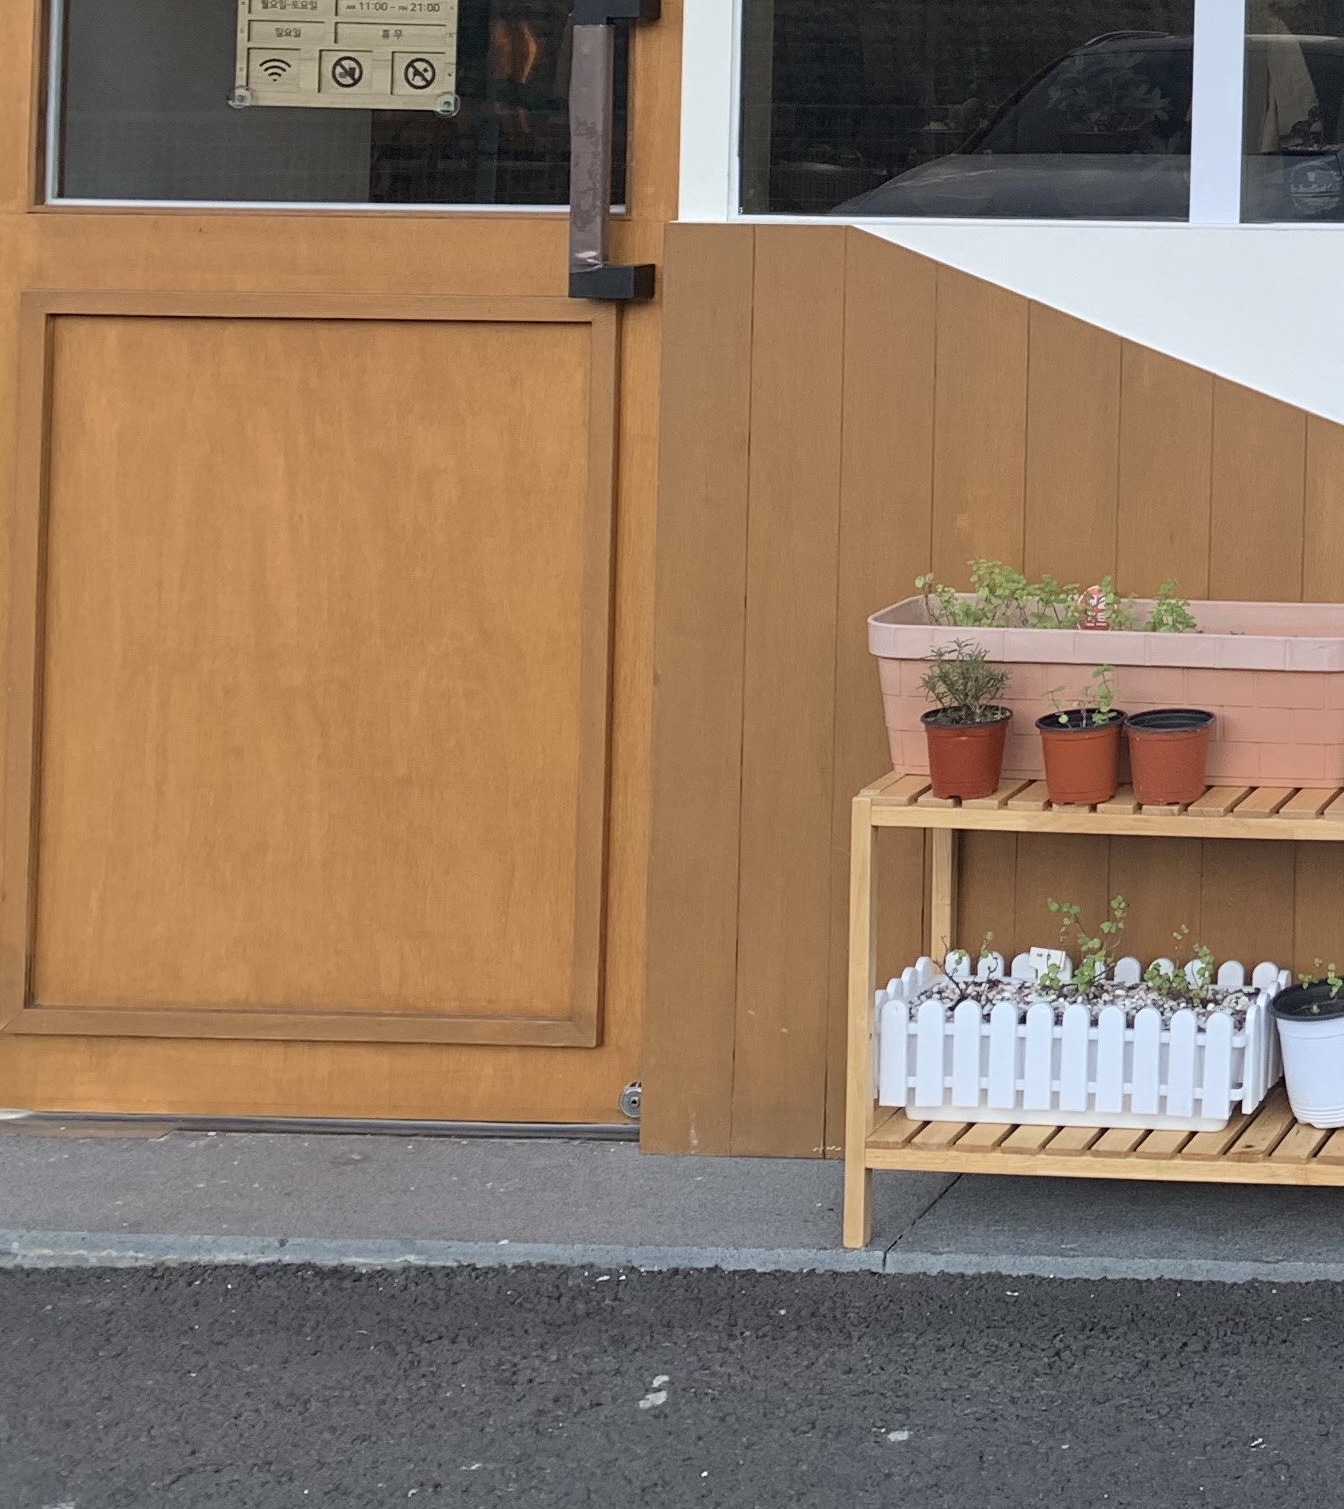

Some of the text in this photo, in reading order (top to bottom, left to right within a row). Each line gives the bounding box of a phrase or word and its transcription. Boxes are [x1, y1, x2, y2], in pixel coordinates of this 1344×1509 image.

[358, 1, 388, 12] 11:00
[410, 2, 441, 13] 21:00
[274, 27, 302, 39] 일요일
